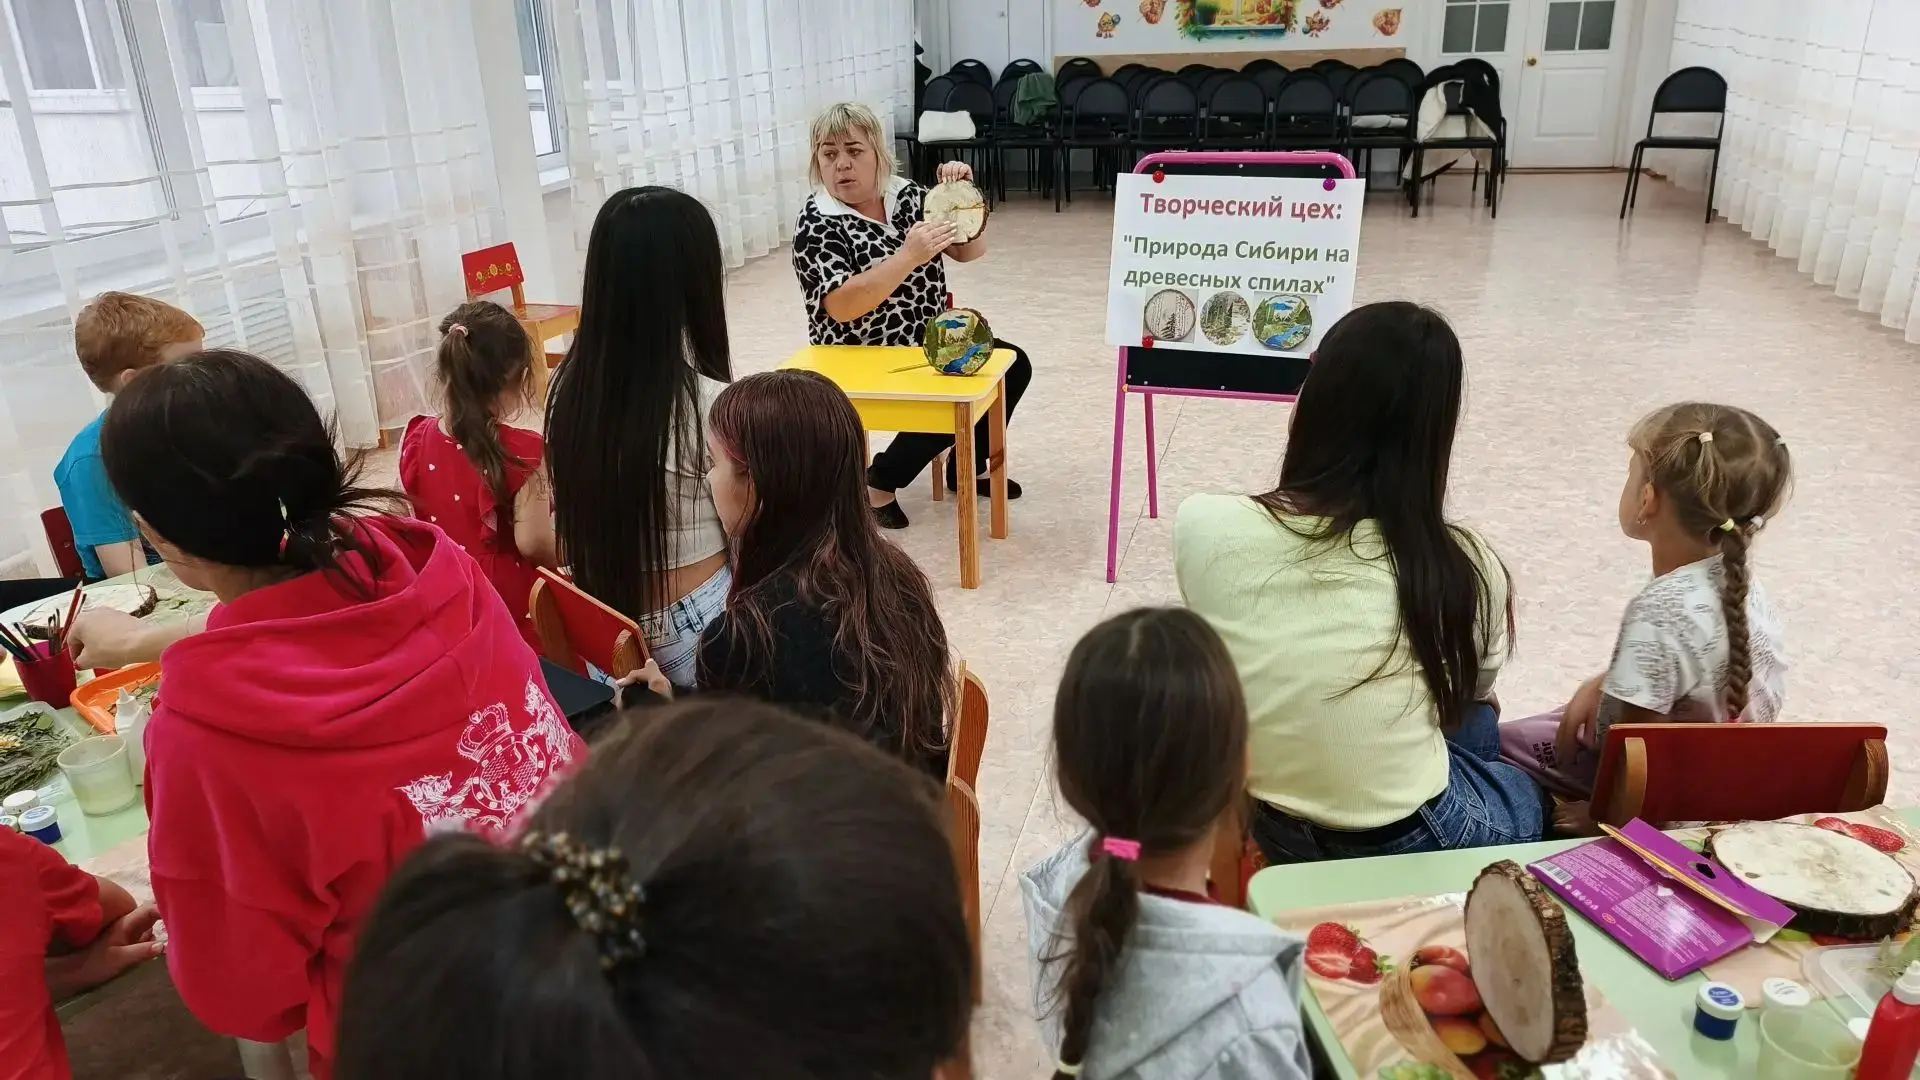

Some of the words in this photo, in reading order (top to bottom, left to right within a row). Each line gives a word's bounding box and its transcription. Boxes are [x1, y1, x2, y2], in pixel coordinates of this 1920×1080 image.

[1139, 193, 1282, 219] Творческий
[1290, 202, 1343, 222] цех:
[1123, 235, 1229, 260] "Природа
[1235, 240, 1319, 264] Сибири
[1325, 248, 1350, 263] на
[1123, 269, 1242, 289] древесных
[1247, 275, 1336, 294] спилах"
